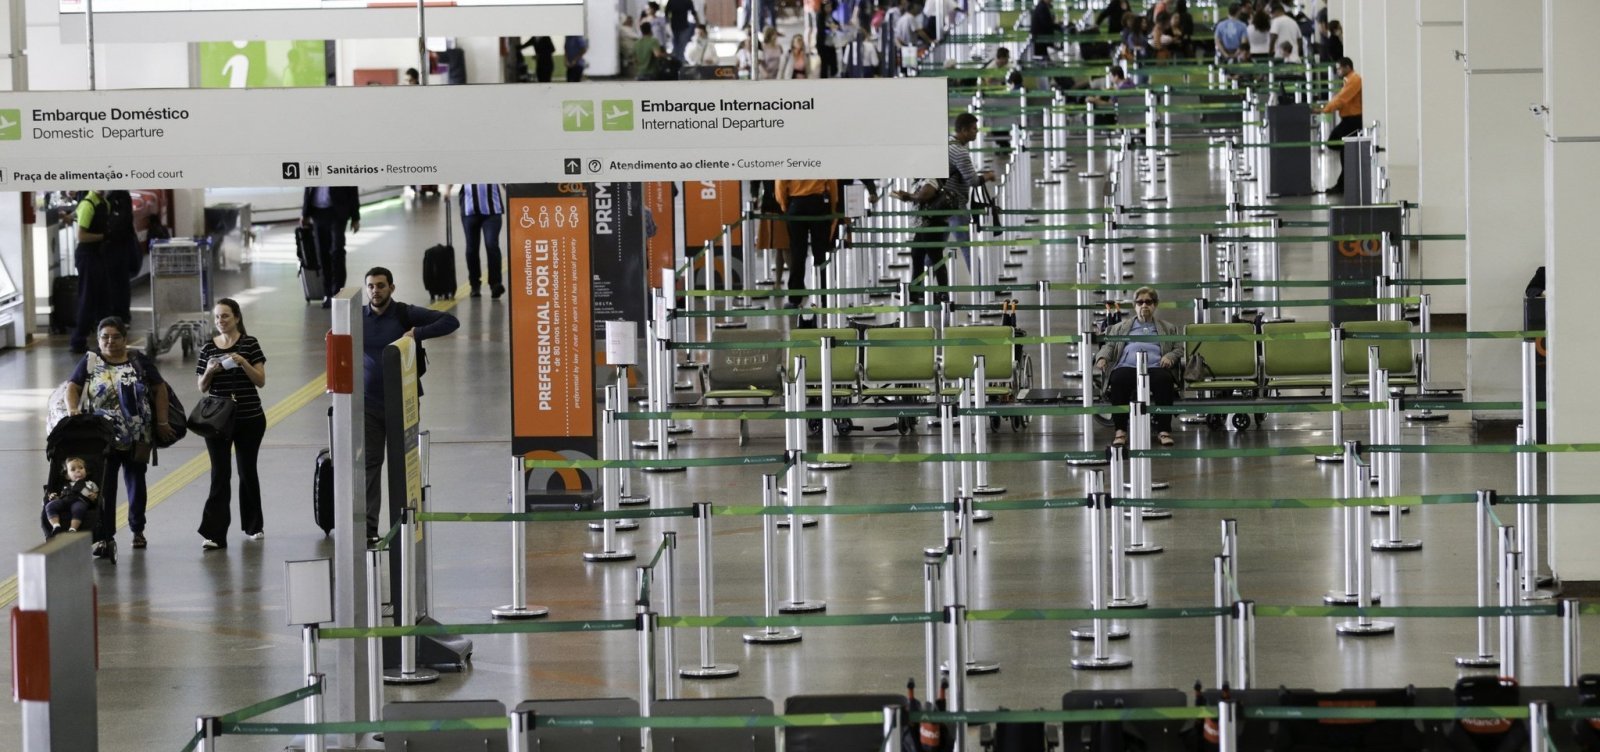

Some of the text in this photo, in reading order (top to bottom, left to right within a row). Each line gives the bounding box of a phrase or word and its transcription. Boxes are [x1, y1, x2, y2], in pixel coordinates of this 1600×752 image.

[641, 97, 815, 115] Embarque Internacional
[32, 107, 189, 123] Embarque Doméstico
[641, 116, 785, 132] International Departure
[32, 126, 165, 141] Domestic Departure
[326, 163, 438, 175] Sanitários Restrooms
[609, 157, 822, 171] Atendimento ao cliente Customer Service
[13, 168, 184, 183] Praça de alimentação Food court
[550, 239, 560, 269] especial
[570, 238, 578, 261] priority
[524, 239, 533, 296] atendimento
[570, 262, 579, 282] special
[551, 270, 561, 308] prioridade
[570, 283, 578, 294] has
[552, 310, 560, 325] tem
[571, 306, 579, 323] years
[535, 239, 552, 411] PREFERENCIAL POR LEI
[571, 324, 578, 332] 80
[553, 326, 561, 345] anos
[553, 346, 561, 356] 80
[553, 357, 561, 367] de
